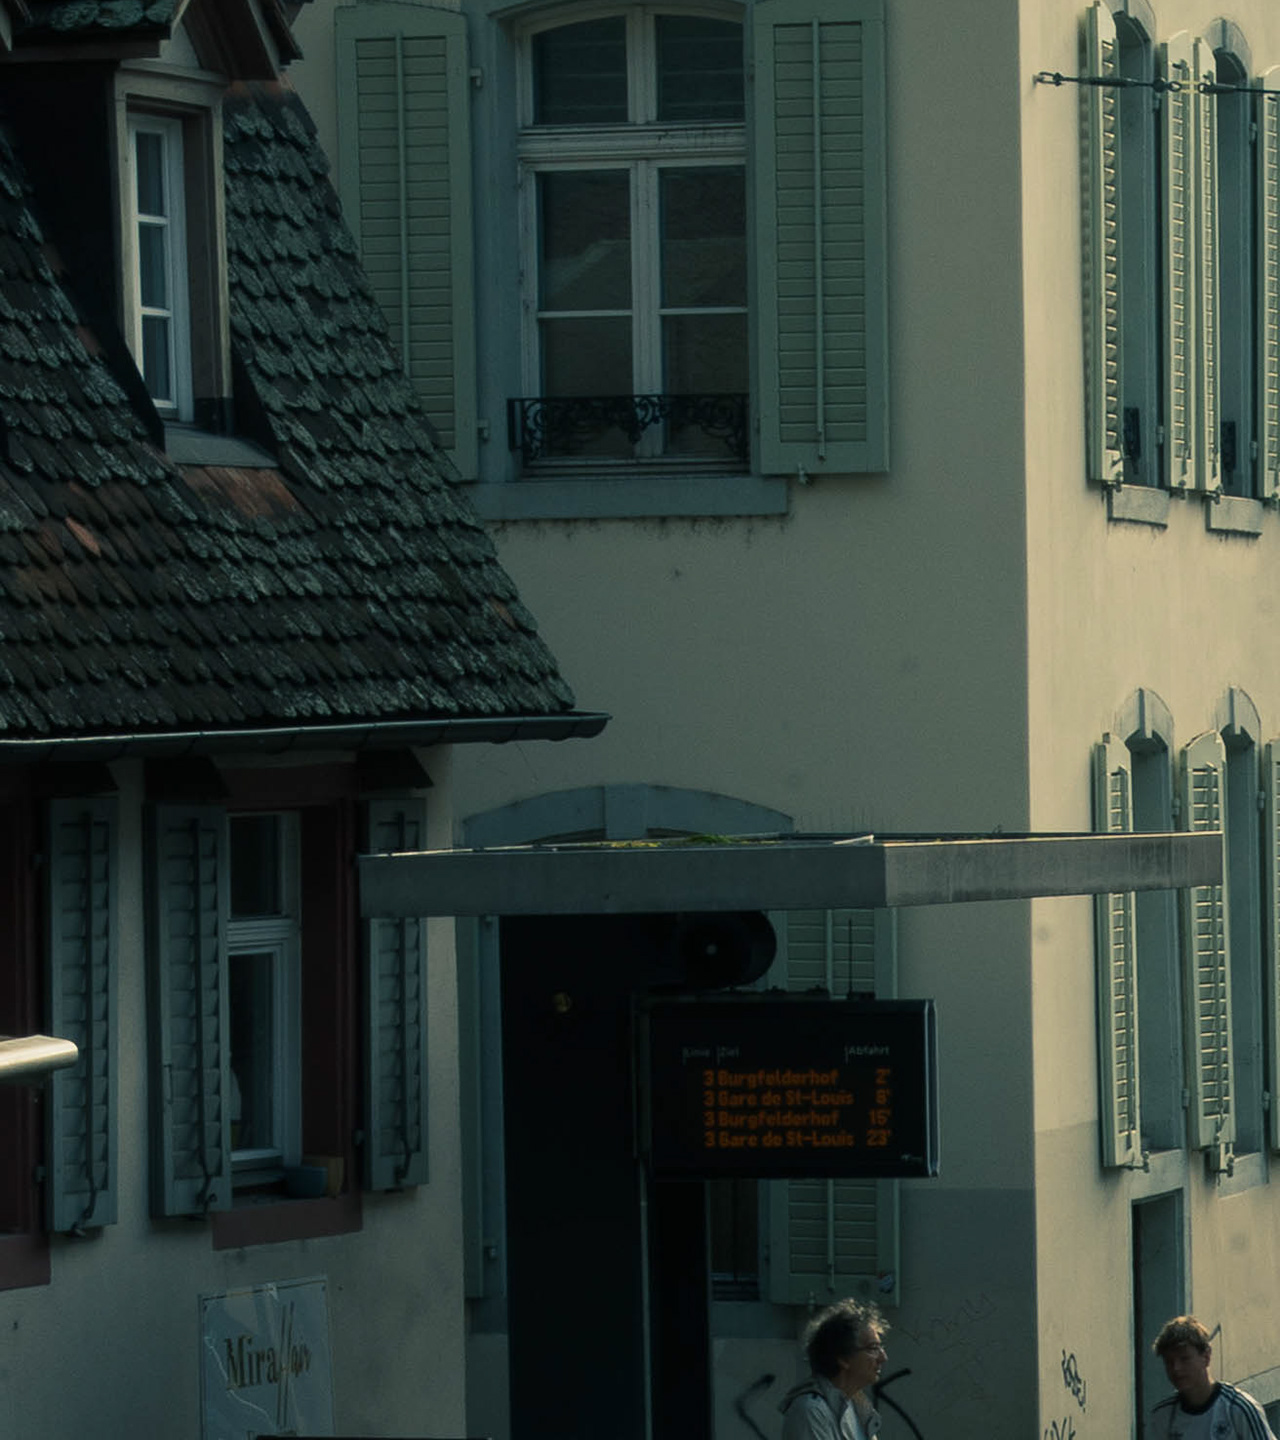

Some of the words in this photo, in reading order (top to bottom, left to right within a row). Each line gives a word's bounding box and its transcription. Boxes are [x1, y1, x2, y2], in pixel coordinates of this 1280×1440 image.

[703, 1068, 714, 1086] 3
[718, 1068, 839, 1088] Burgfelderhof
[703, 1090, 714, 1107] 3
[718, 1090, 756, 1106] Gare
[761, 1090, 781, 1106] de
[786, 1089, 854, 1106] St-Louis
[703, 1110, 714, 1127] 3
[718, 1110, 839, 1128] Burgfelderhof
[704, 1131, 715, 1148] 3
[719, 1131, 757, 1148] Gare
[762, 1131, 782, 1148] de
[786, 1130, 855, 1148] St-Louis
